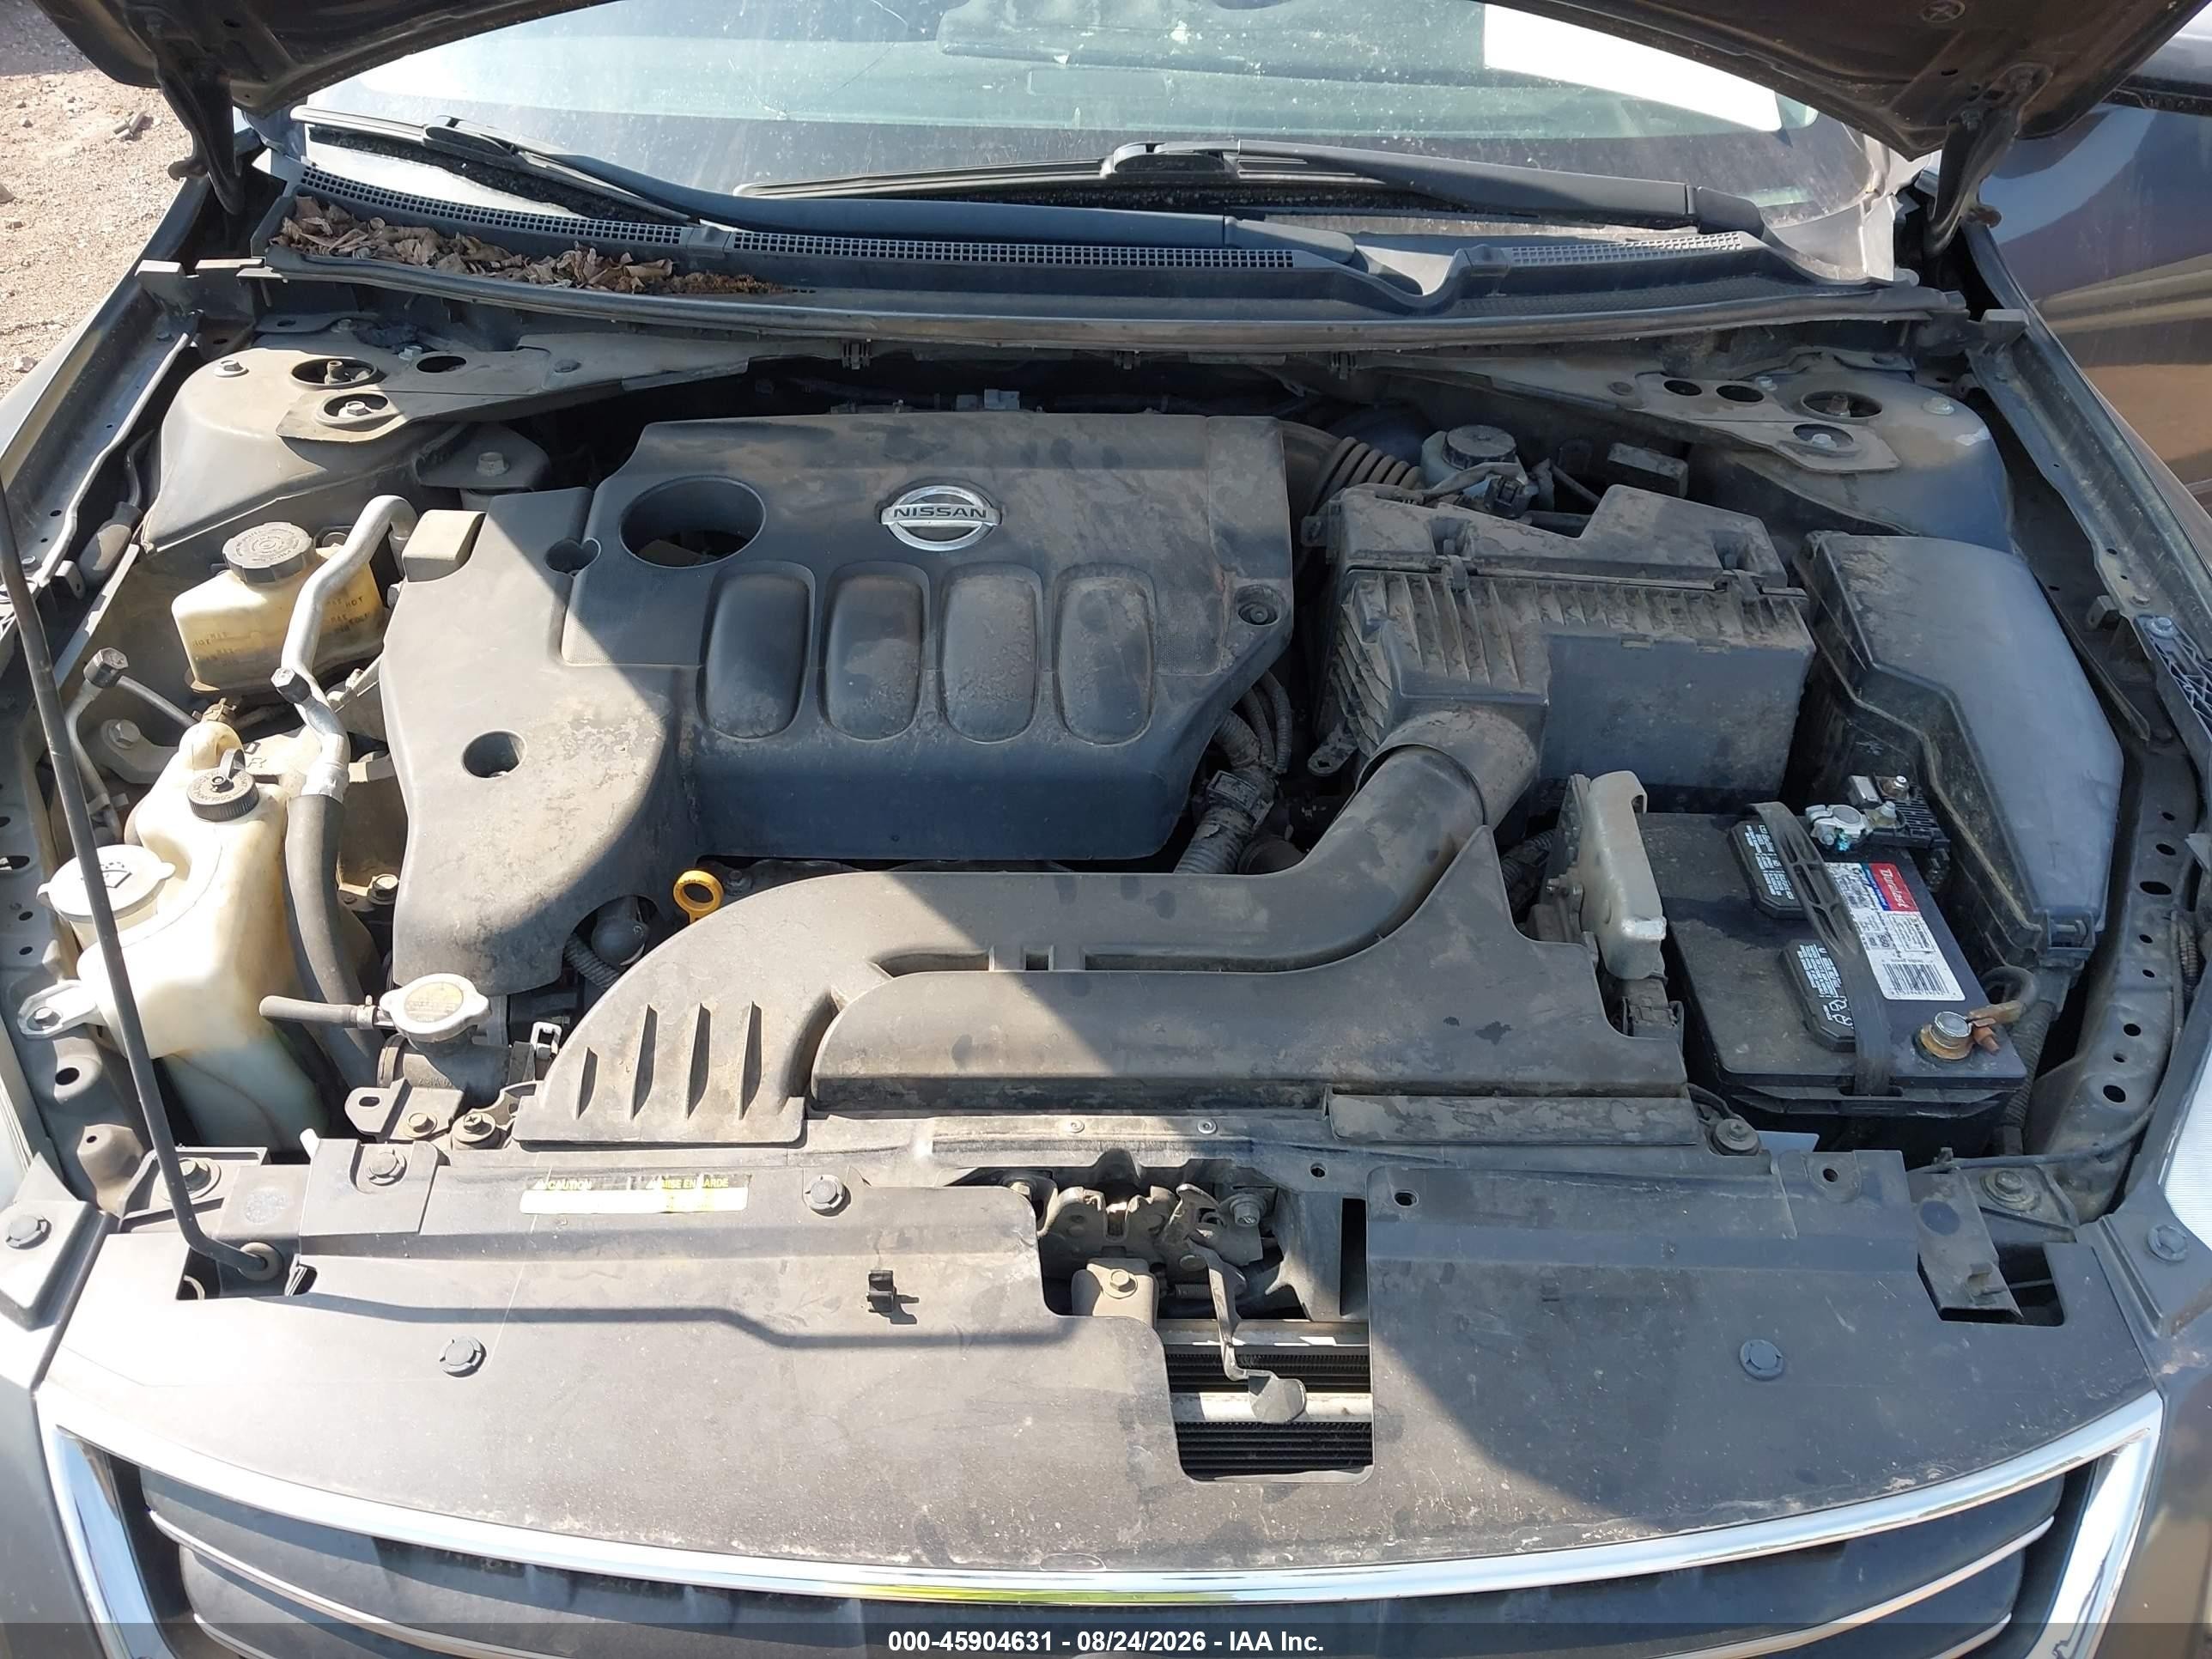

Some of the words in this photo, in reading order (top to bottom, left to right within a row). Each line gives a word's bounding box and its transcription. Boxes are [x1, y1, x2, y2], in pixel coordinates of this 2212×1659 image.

[893, 507, 987, 519] NISSAN
[1880, 868, 1911, 908] Duralast
[549, 1178, 592, 1190] CAUTION
